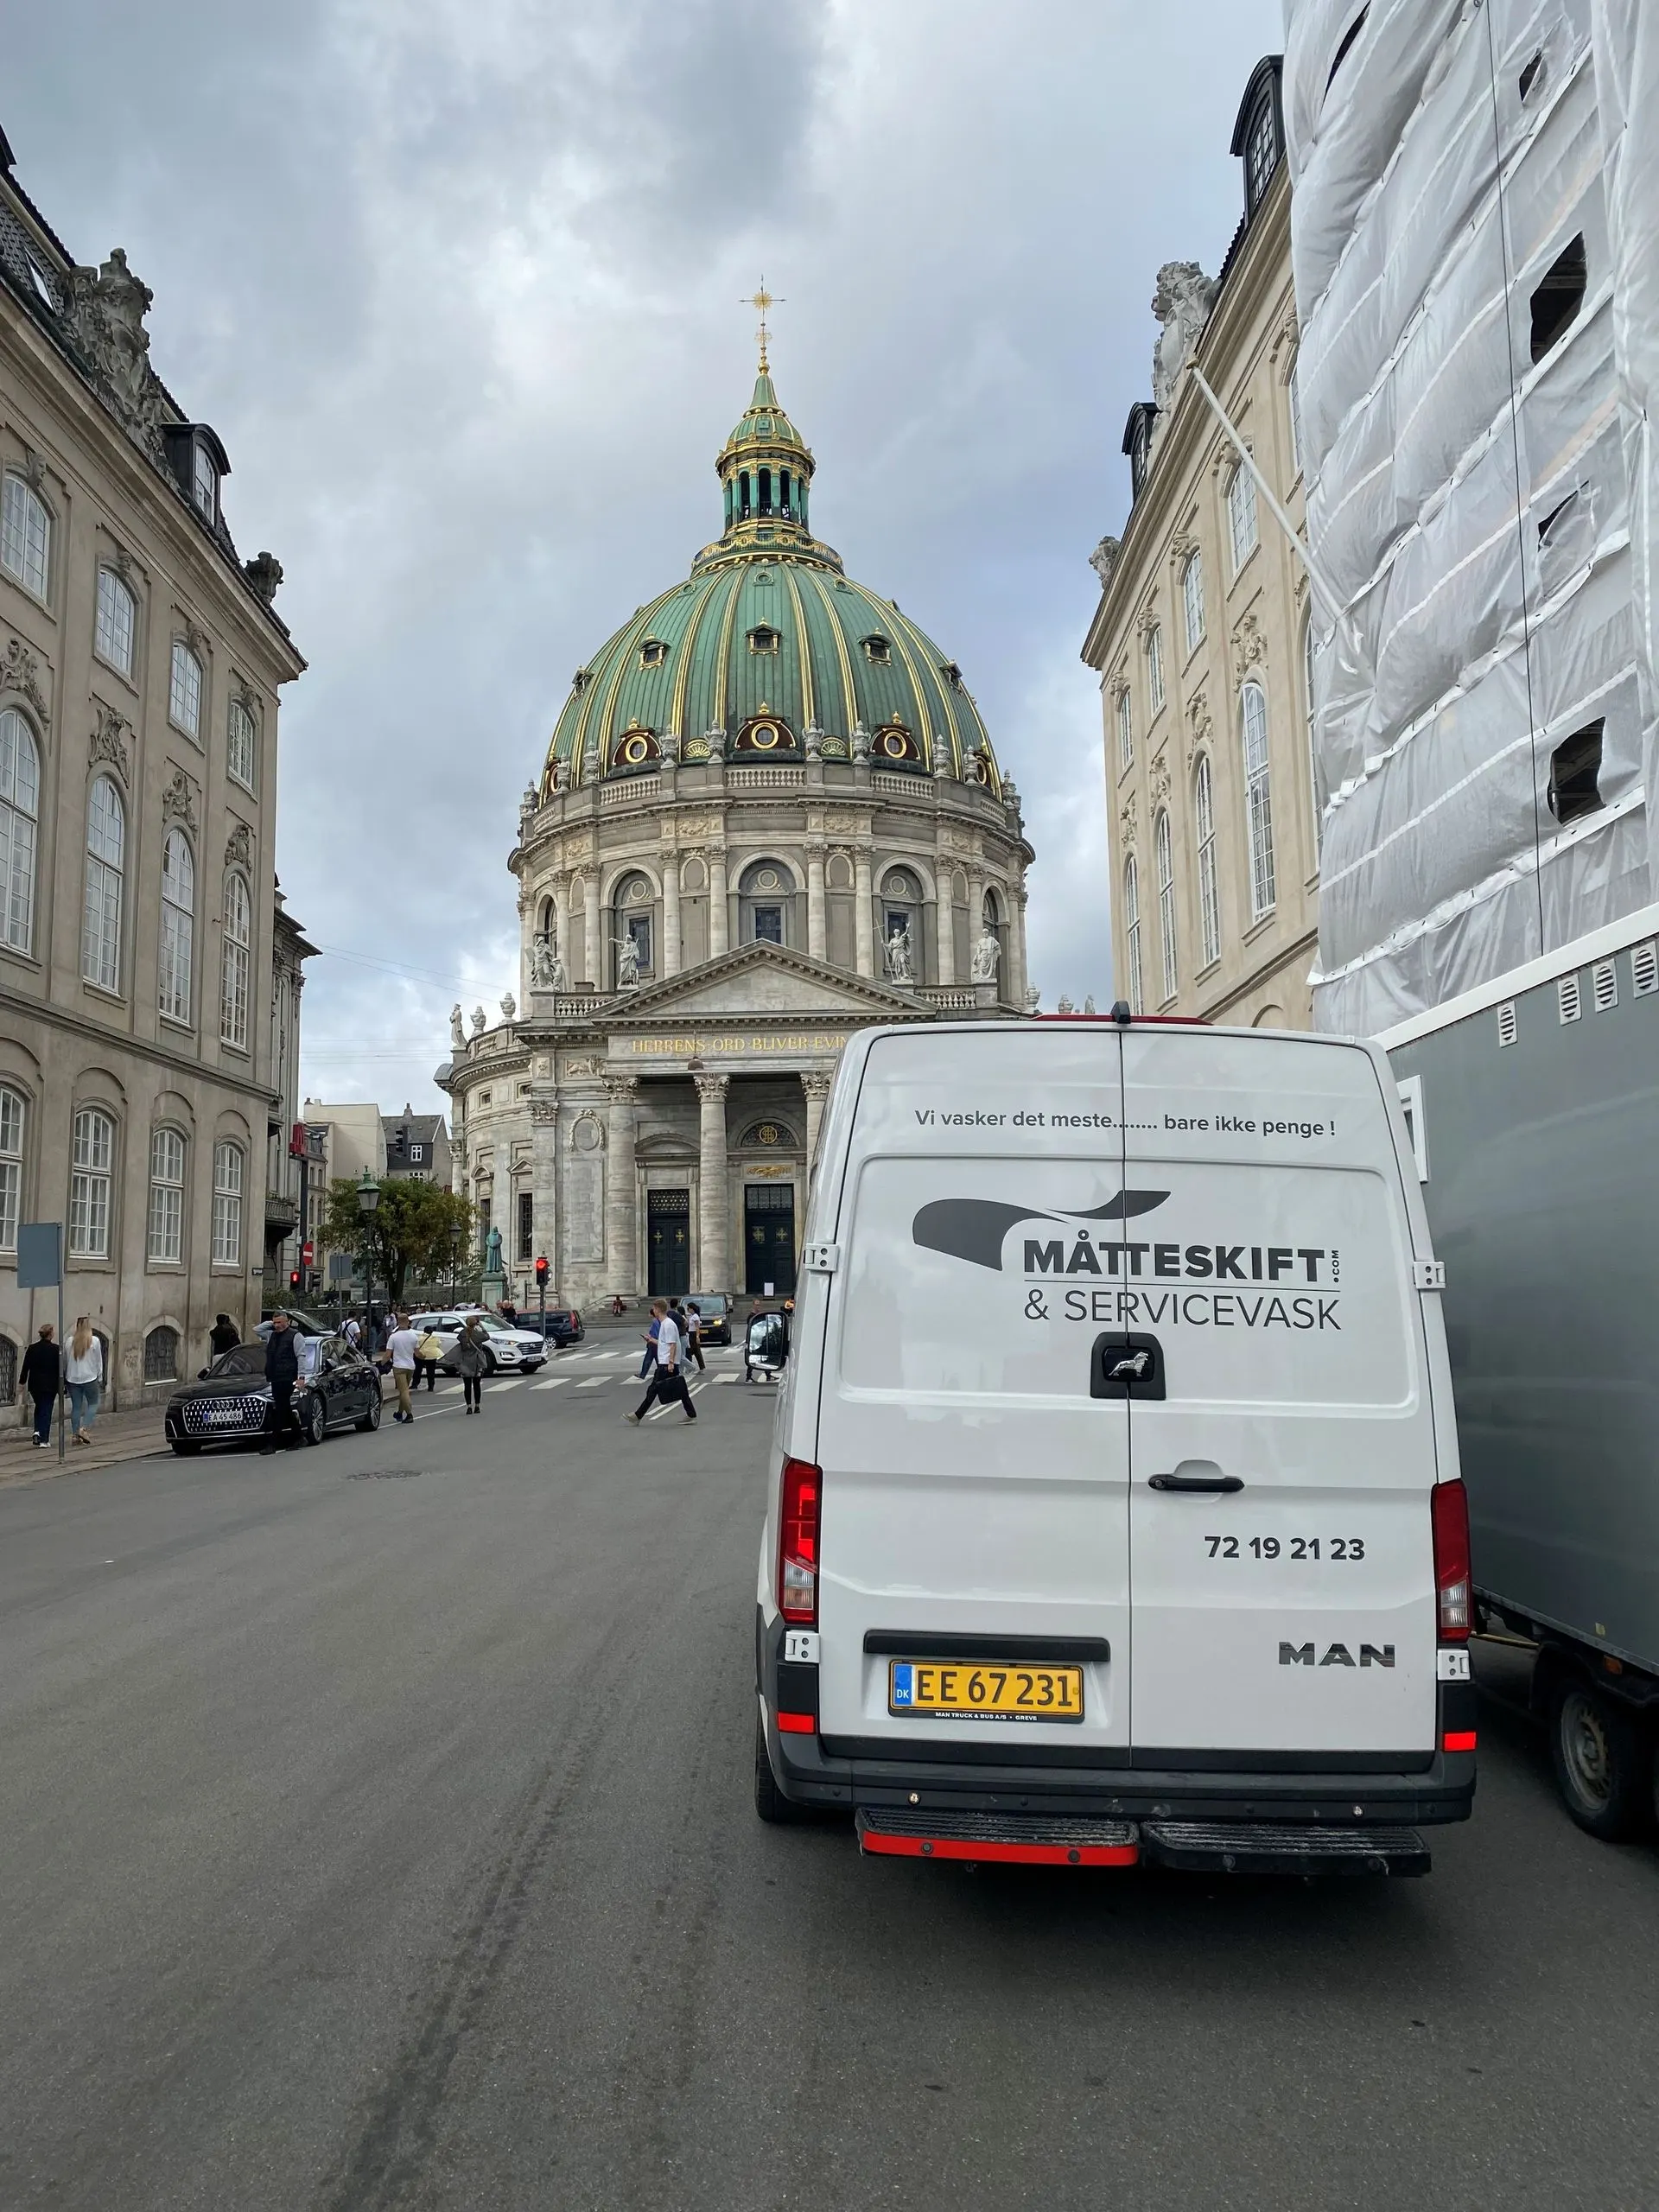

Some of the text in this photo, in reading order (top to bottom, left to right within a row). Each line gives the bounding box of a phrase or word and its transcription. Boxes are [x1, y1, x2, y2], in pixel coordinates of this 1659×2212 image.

[632, 1038, 705, 1052] HERRENS
[713, 1038, 745, 1052] ORD
[752, 1036, 808, 1051] BLIVER
[915, 1109, 935, 1125] Vi
[941, 1110, 1007, 1126] vasker
[1013, 1111, 1046, 1127] det
[1164, 1114, 1209, 1130] bare
[1215, 1116, 1256, 1133] ikke
[1262, 1121, 1325, 1139] penge
[1024, 1230, 1325, 1282] MÅTTESKIFT
[1024, 1289, 1342, 1331] & SERVICEVASK
[1205, 1535, 1365, 1560] 72 19 21 23
[1278, 1641, 1395, 1668] MAN
[896, 1688, 910, 1700] DK
[917, 1669, 1073, 1707] EE 67 231
